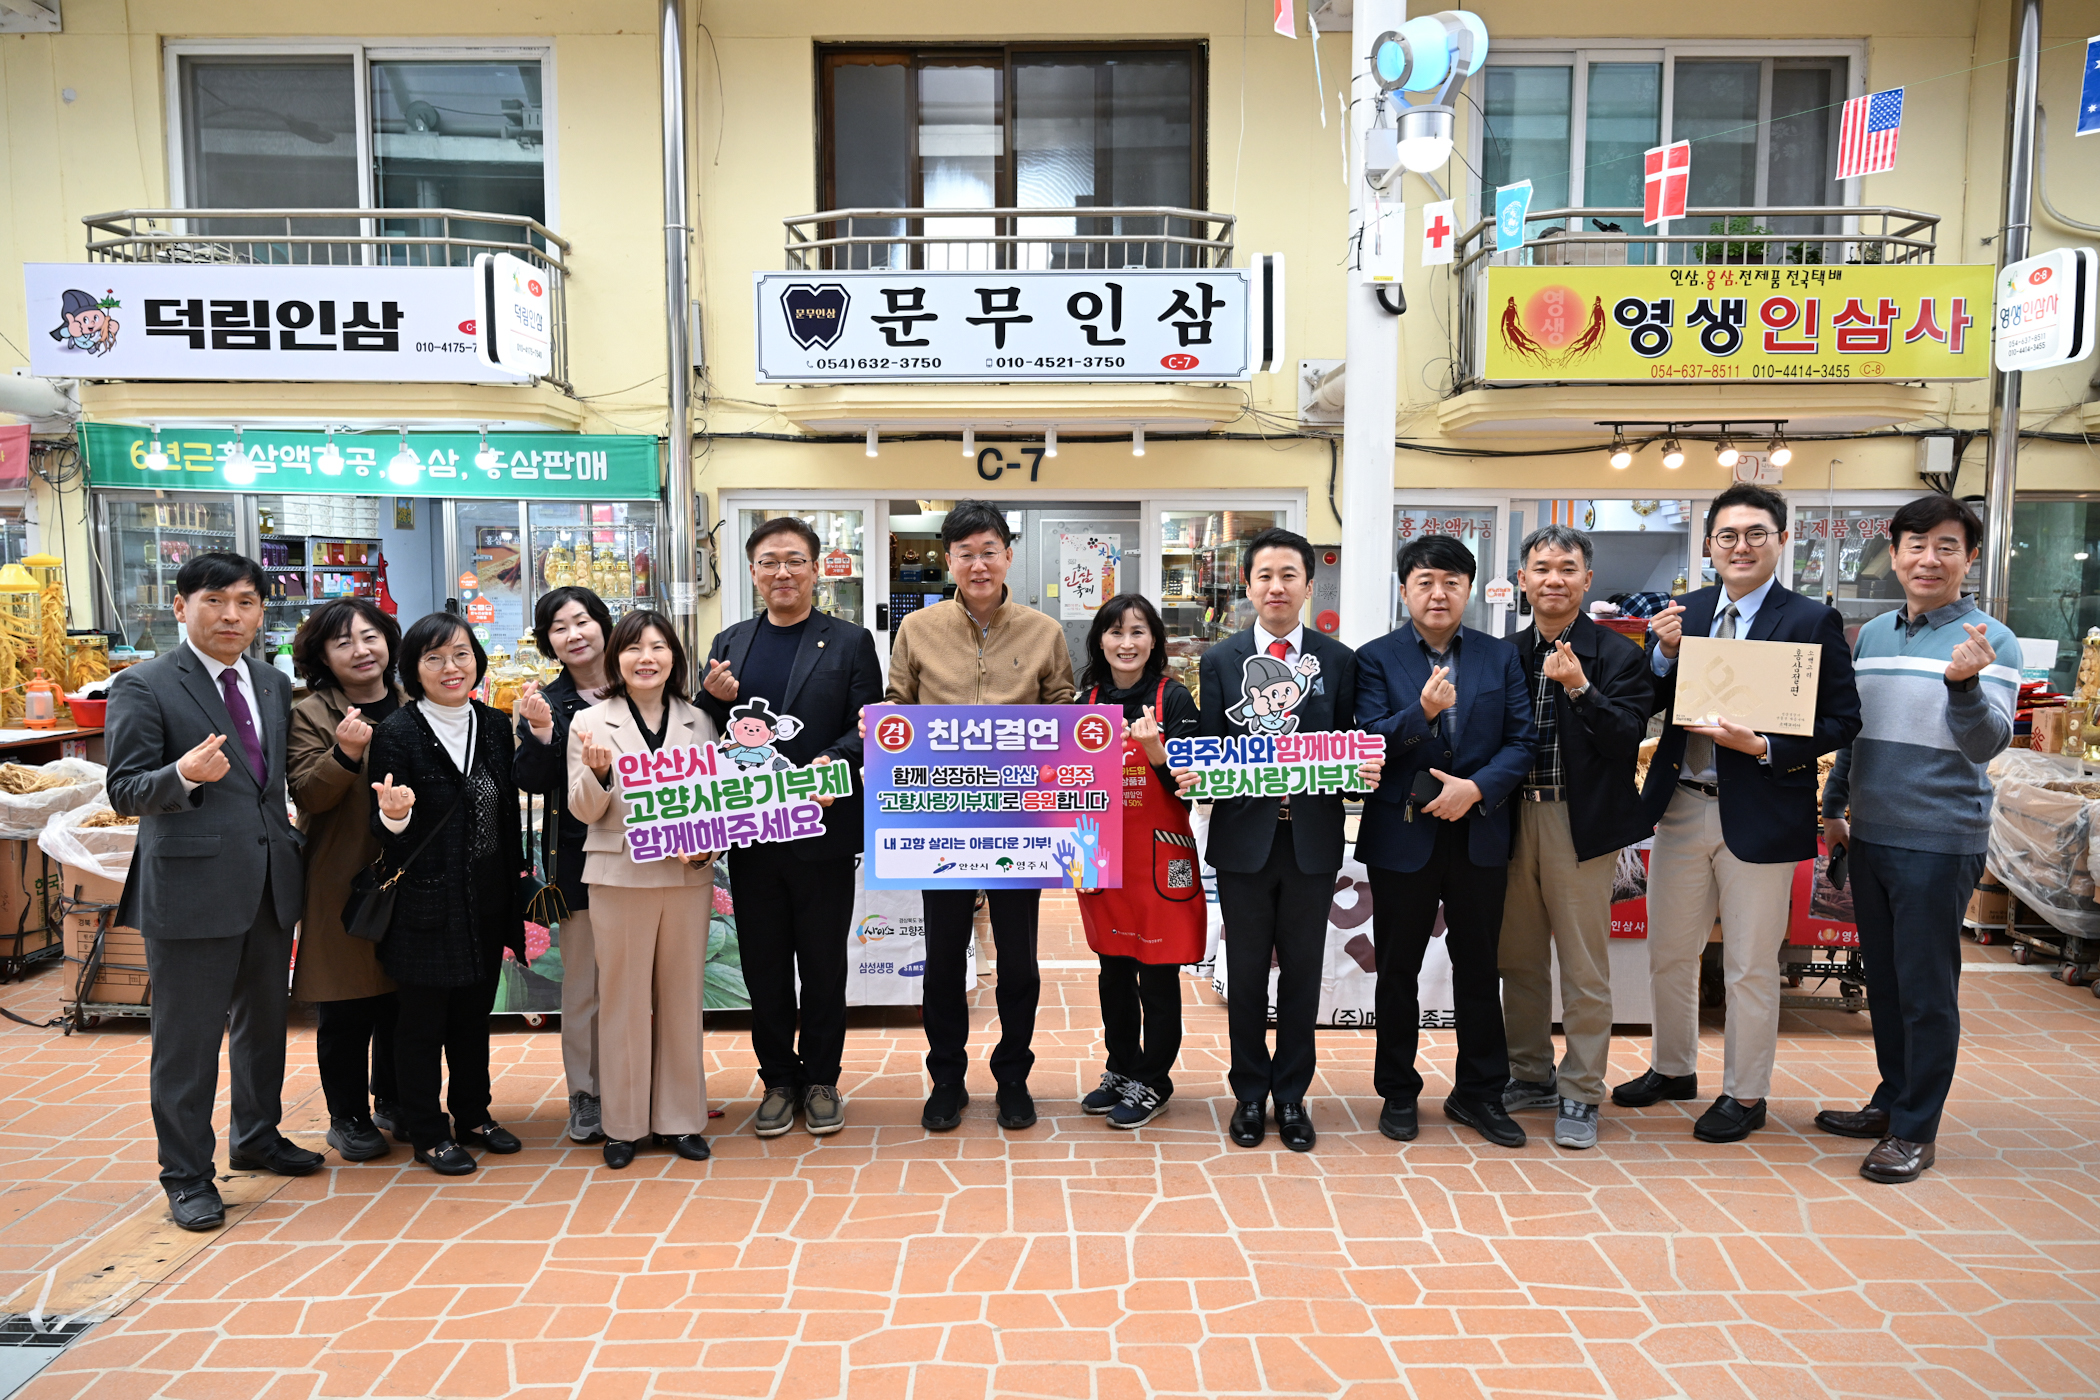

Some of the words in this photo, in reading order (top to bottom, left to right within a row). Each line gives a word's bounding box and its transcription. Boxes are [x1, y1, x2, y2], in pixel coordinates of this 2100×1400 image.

[2033, 269, 2048, 283] C-8
[514, 303, 543, 332] 덕림인삼
[795, 307, 837, 320] 문무인삼
[1541, 289, 1566, 345] 영생
[2000, 293, 2059, 329] 영생인삼사
[144, 298, 405, 352] 덕림인삼
[1612, 296, 1973, 357] 영생인삼사
[415, 341, 477, 353] 010-4175-7
[2008, 332, 2046, 348] 054-637-8511
[2008, 341, 2046, 357] 010-4414-3455
[816, 357, 942, 370] 054)632-3750
[996, 356, 1126, 369] 010-4521-3750
[1168, 356, 1192, 369] C-7
[1651, 364, 1740, 379] 054-637-8511
[1752, 364, 1850, 379] 010-4414-3455
[1863, 364, 1881, 376] C-8
[976, 447, 1046, 483] C-7
[1064, 569, 1094, 587] 인삼
[1073, 583, 1094, 599] 축제
[881, 721, 906, 746] 경
[927, 717, 1060, 751] 친선결연
[1081, 721, 1105, 745] 축
[618, 743, 718, 788] 안산시
[893, 766, 928, 787] 함께
[931, 765, 1001, 786] 성장하는
[1002, 765, 1037, 785] 안산
[1057, 765, 1093, 786] 영주
[623, 762, 850, 825] 고향사랑기부제
[1022, 791, 1108, 810] 응원합니다
[628, 803, 824, 861] 함께해주세요
[883, 837, 897, 850] 내
[900, 837, 925, 850] 고향
[928, 837, 967, 850] 살리는
[969, 837, 1020, 850] 아름다운
[1022, 836, 1052, 850] 기부!
[958, 862, 989, 871] 안산시
[1016, 860, 1048, 871] 영주시
[858, 962, 894, 974] 삼성생명
[903, 964, 924, 972] SAMS
